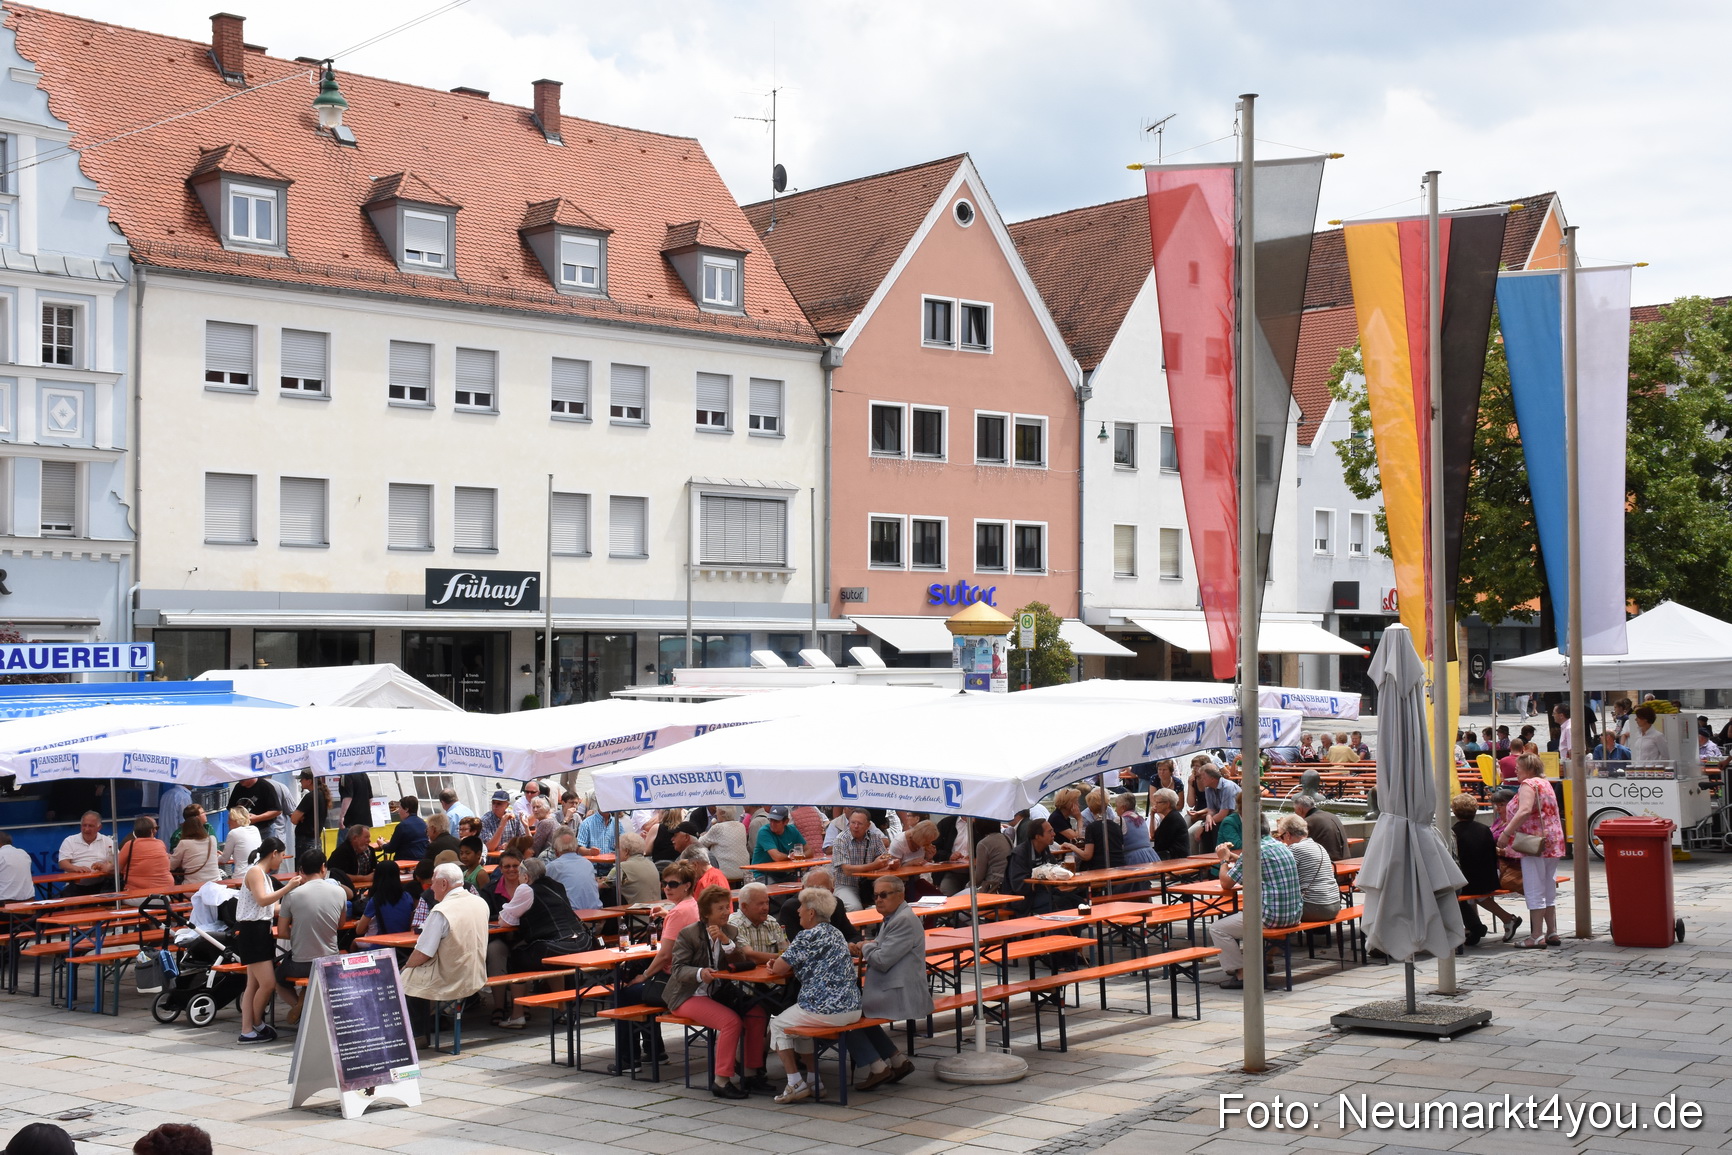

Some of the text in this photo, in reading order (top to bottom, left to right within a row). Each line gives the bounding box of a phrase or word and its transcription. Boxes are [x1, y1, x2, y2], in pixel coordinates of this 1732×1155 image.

[0, 647, 119, 669] AUEREI
[651, 771, 722, 786] GANSBRÄU
[859, 771, 941, 789] GANSBRÄU
[1609, 783, 1663, 801] Crêpe
